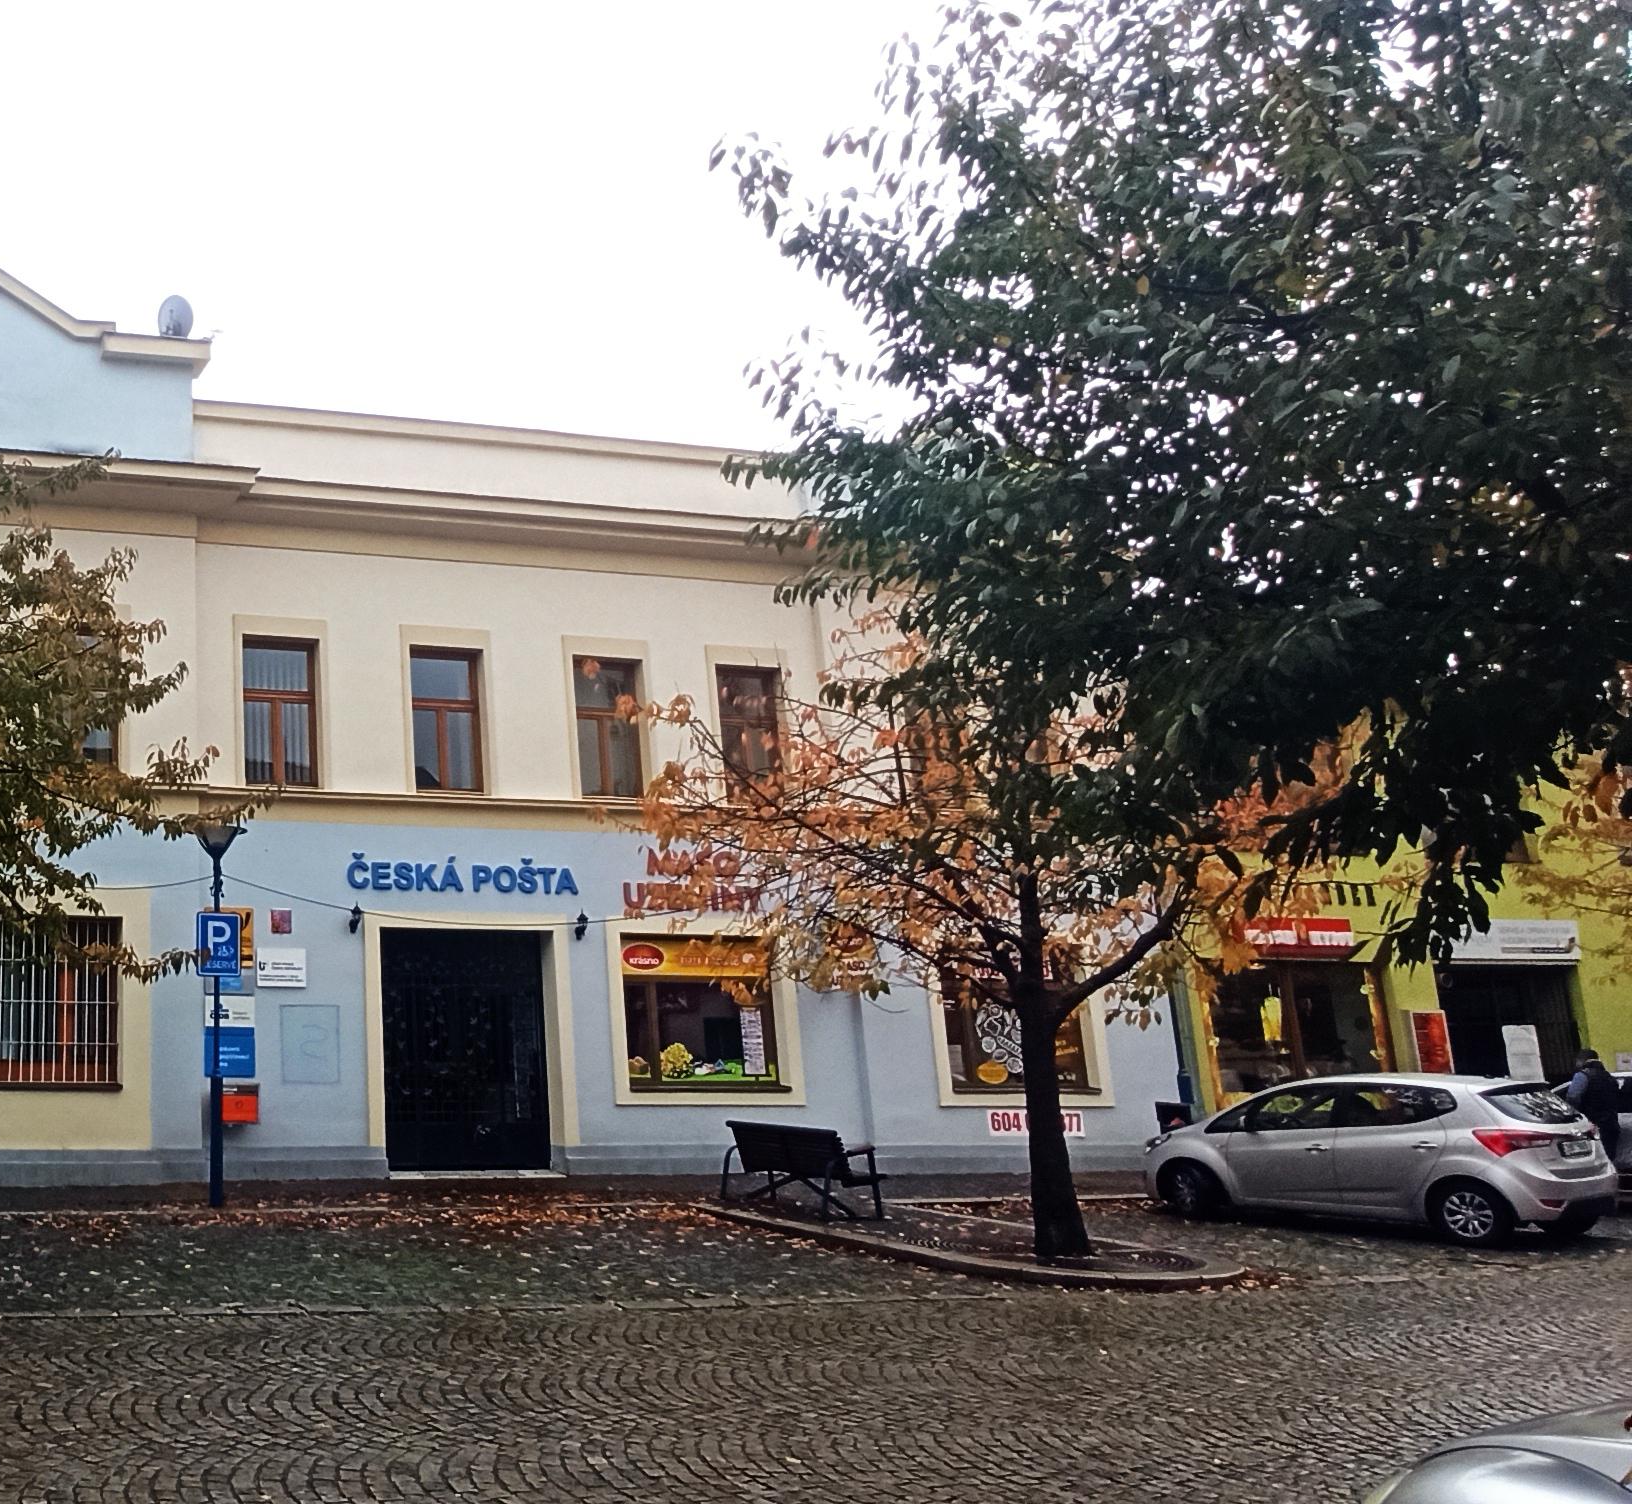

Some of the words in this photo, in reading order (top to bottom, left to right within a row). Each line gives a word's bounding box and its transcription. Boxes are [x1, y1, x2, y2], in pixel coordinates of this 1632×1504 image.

[347, 852, 464, 892] ČESKÁ
[471, 858, 579, 895] POŠTA
[207, 920, 231, 956] P
[990, 1112, 1023, 1132] 604
